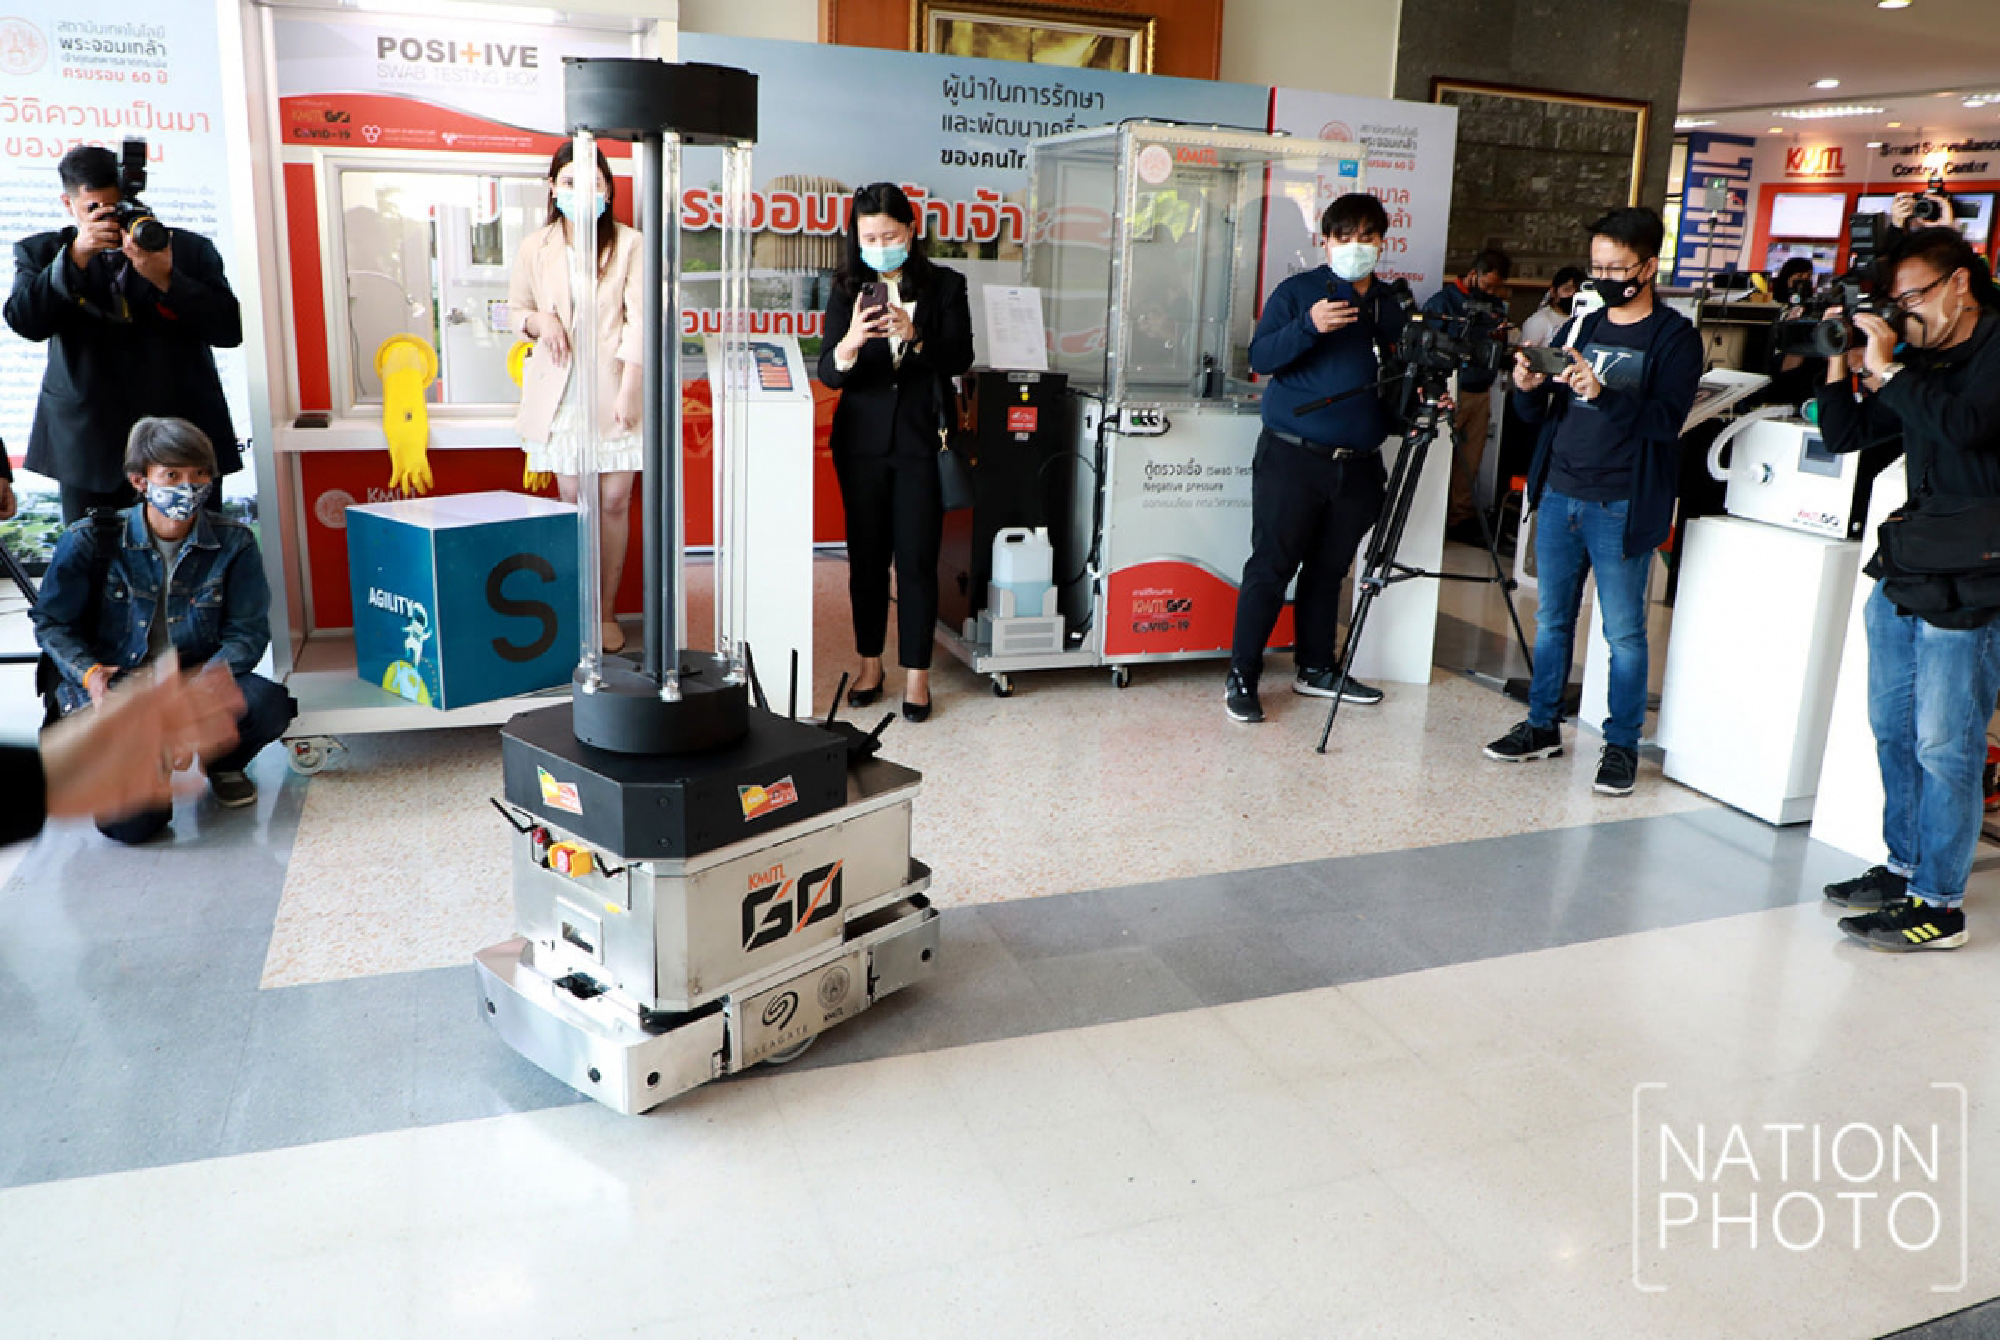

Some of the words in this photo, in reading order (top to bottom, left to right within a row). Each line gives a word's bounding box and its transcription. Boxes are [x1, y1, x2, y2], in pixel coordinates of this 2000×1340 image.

[132, 71, 151, 83] 60
[377, 63, 425, 80] SWAB
[943, 72, 1104, 110] ผู้นำในการรักษา
[485, 552, 558, 662] S
